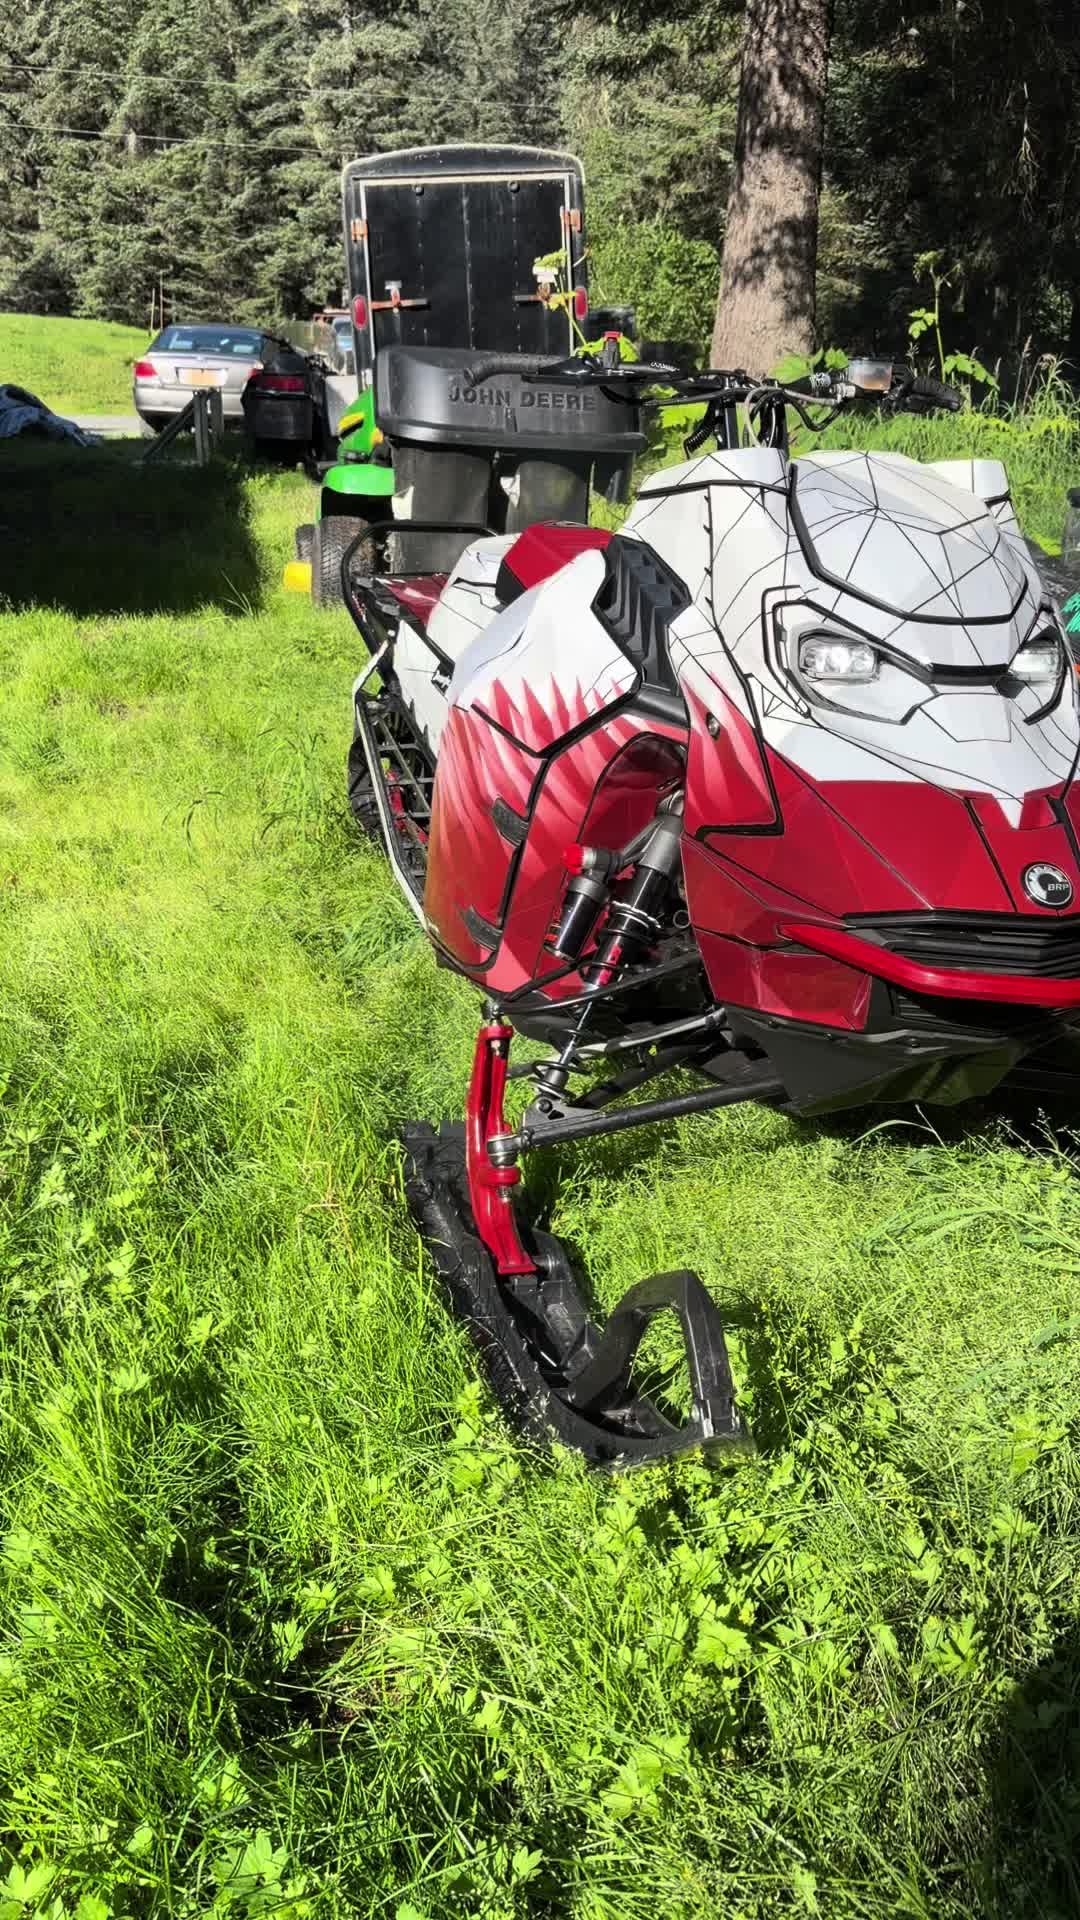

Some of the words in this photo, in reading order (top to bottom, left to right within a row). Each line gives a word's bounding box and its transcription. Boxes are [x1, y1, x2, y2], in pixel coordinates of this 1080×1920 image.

[448, 387, 511, 406] JOHN
[520, 391, 597, 411] DEERE
[1047, 883, 1070, 892] BRP
